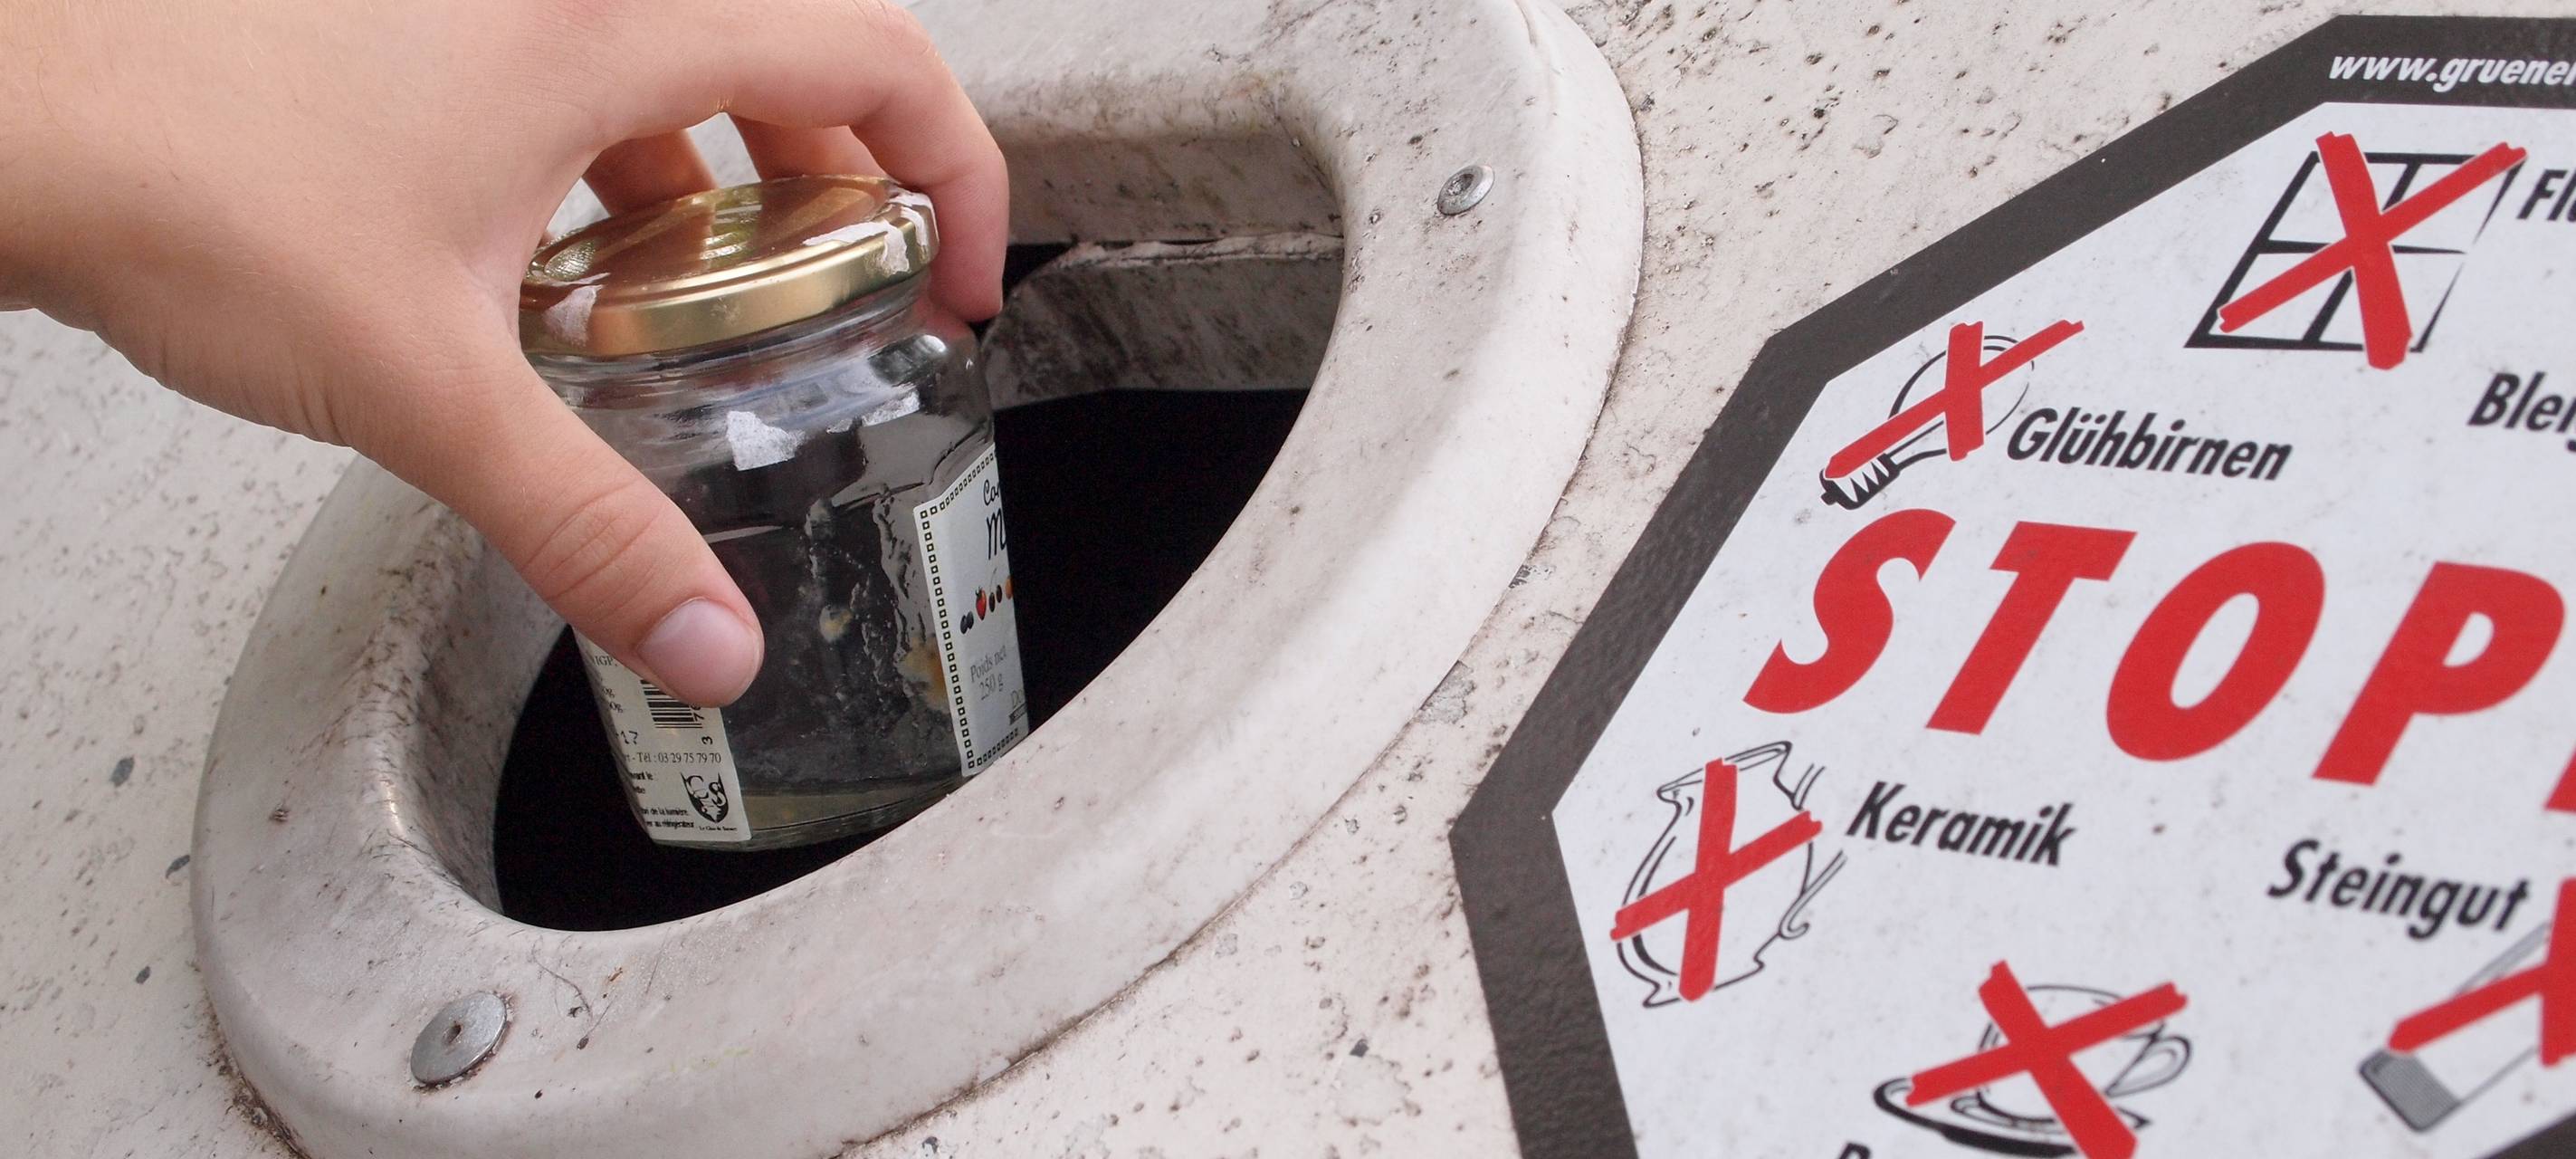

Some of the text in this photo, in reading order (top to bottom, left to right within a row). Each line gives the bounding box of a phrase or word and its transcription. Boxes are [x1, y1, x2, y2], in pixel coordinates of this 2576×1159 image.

[2006, 407, 2294, 481] Glühbirnen
[970, 655, 994, 683] Poids
[979, 673, 1004, 700] 250 g
[1742, 508, 2576, 813] STOP
[658, 752, 668, 763] 03
[671, 752, 682, 763] 29
[683, 752, 694, 763] 75
[697, 752, 708, 763] 79
[709, 752, 721, 763] 70
[1845, 781, 2077, 867] Keramik
[2266, 838, 2532, 940] Steingut
